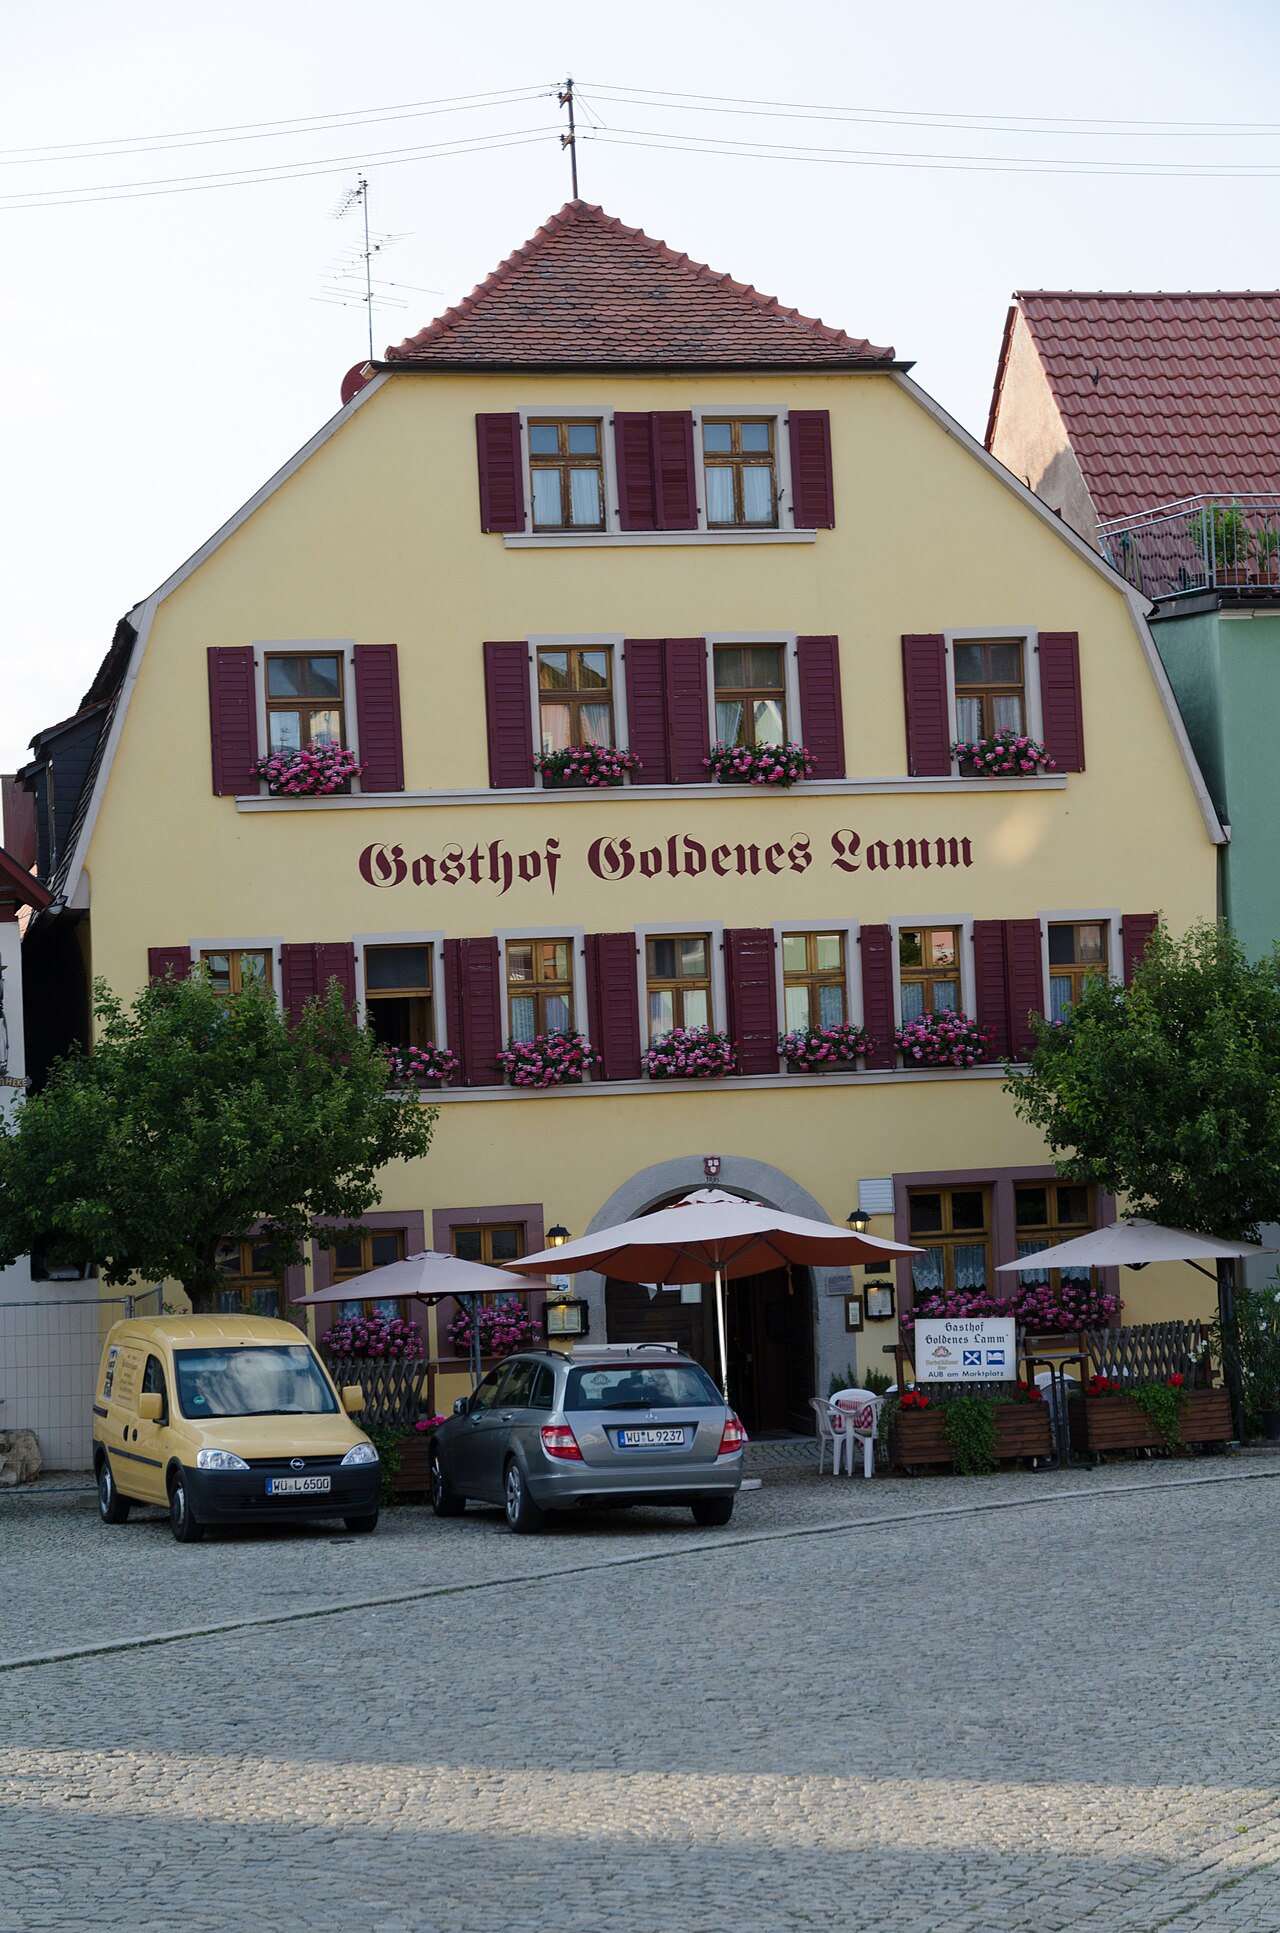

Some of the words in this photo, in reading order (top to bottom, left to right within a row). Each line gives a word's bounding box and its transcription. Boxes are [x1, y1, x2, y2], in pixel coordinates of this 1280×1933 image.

[359, 838, 562, 897] Gasthof
[587, 833, 813, 881] Goldenes
[831, 828, 975, 873] Lamm
[944, 1322, 984, 1332] Gasthof
[925, 1334, 969, 1344] Goldenes
[962, 1370, 1004, 1378] Marktplatz
[656, 1430, 682, 1442] 9237
[303, 1478, 329, 1490] 6500
